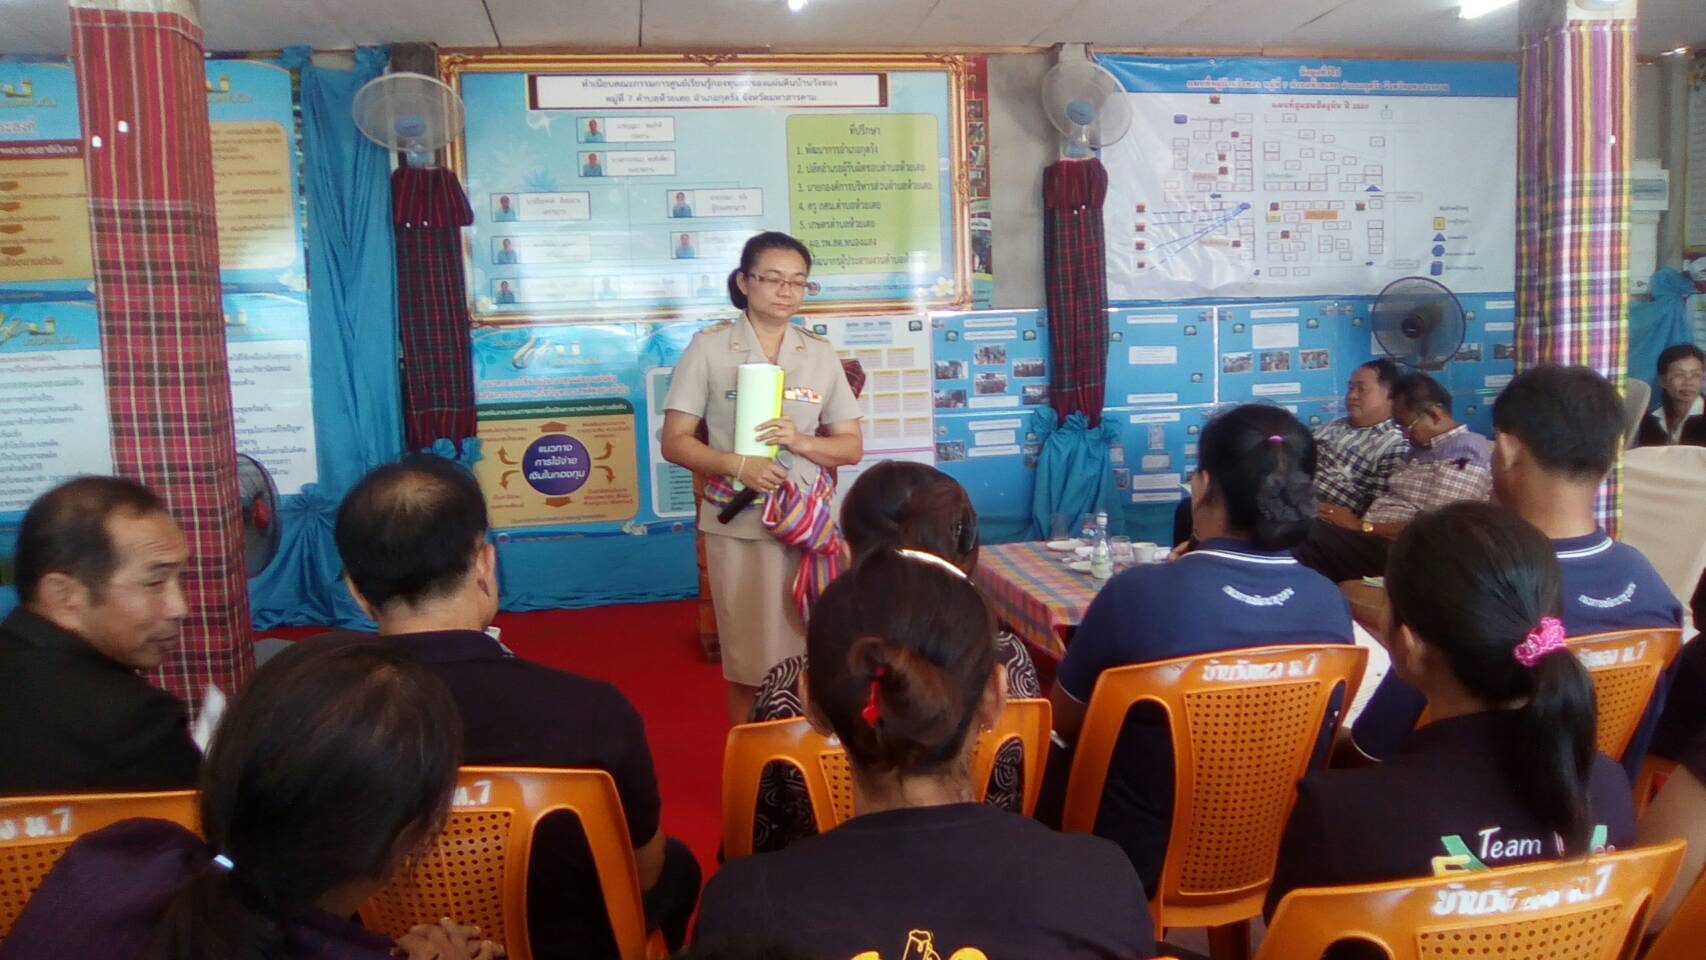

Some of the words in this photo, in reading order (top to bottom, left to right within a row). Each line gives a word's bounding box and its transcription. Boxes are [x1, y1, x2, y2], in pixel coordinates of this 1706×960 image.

[849, 123, 881, 136] ที่ปรึกษา
[1478, 826, 1541, 860] Team
